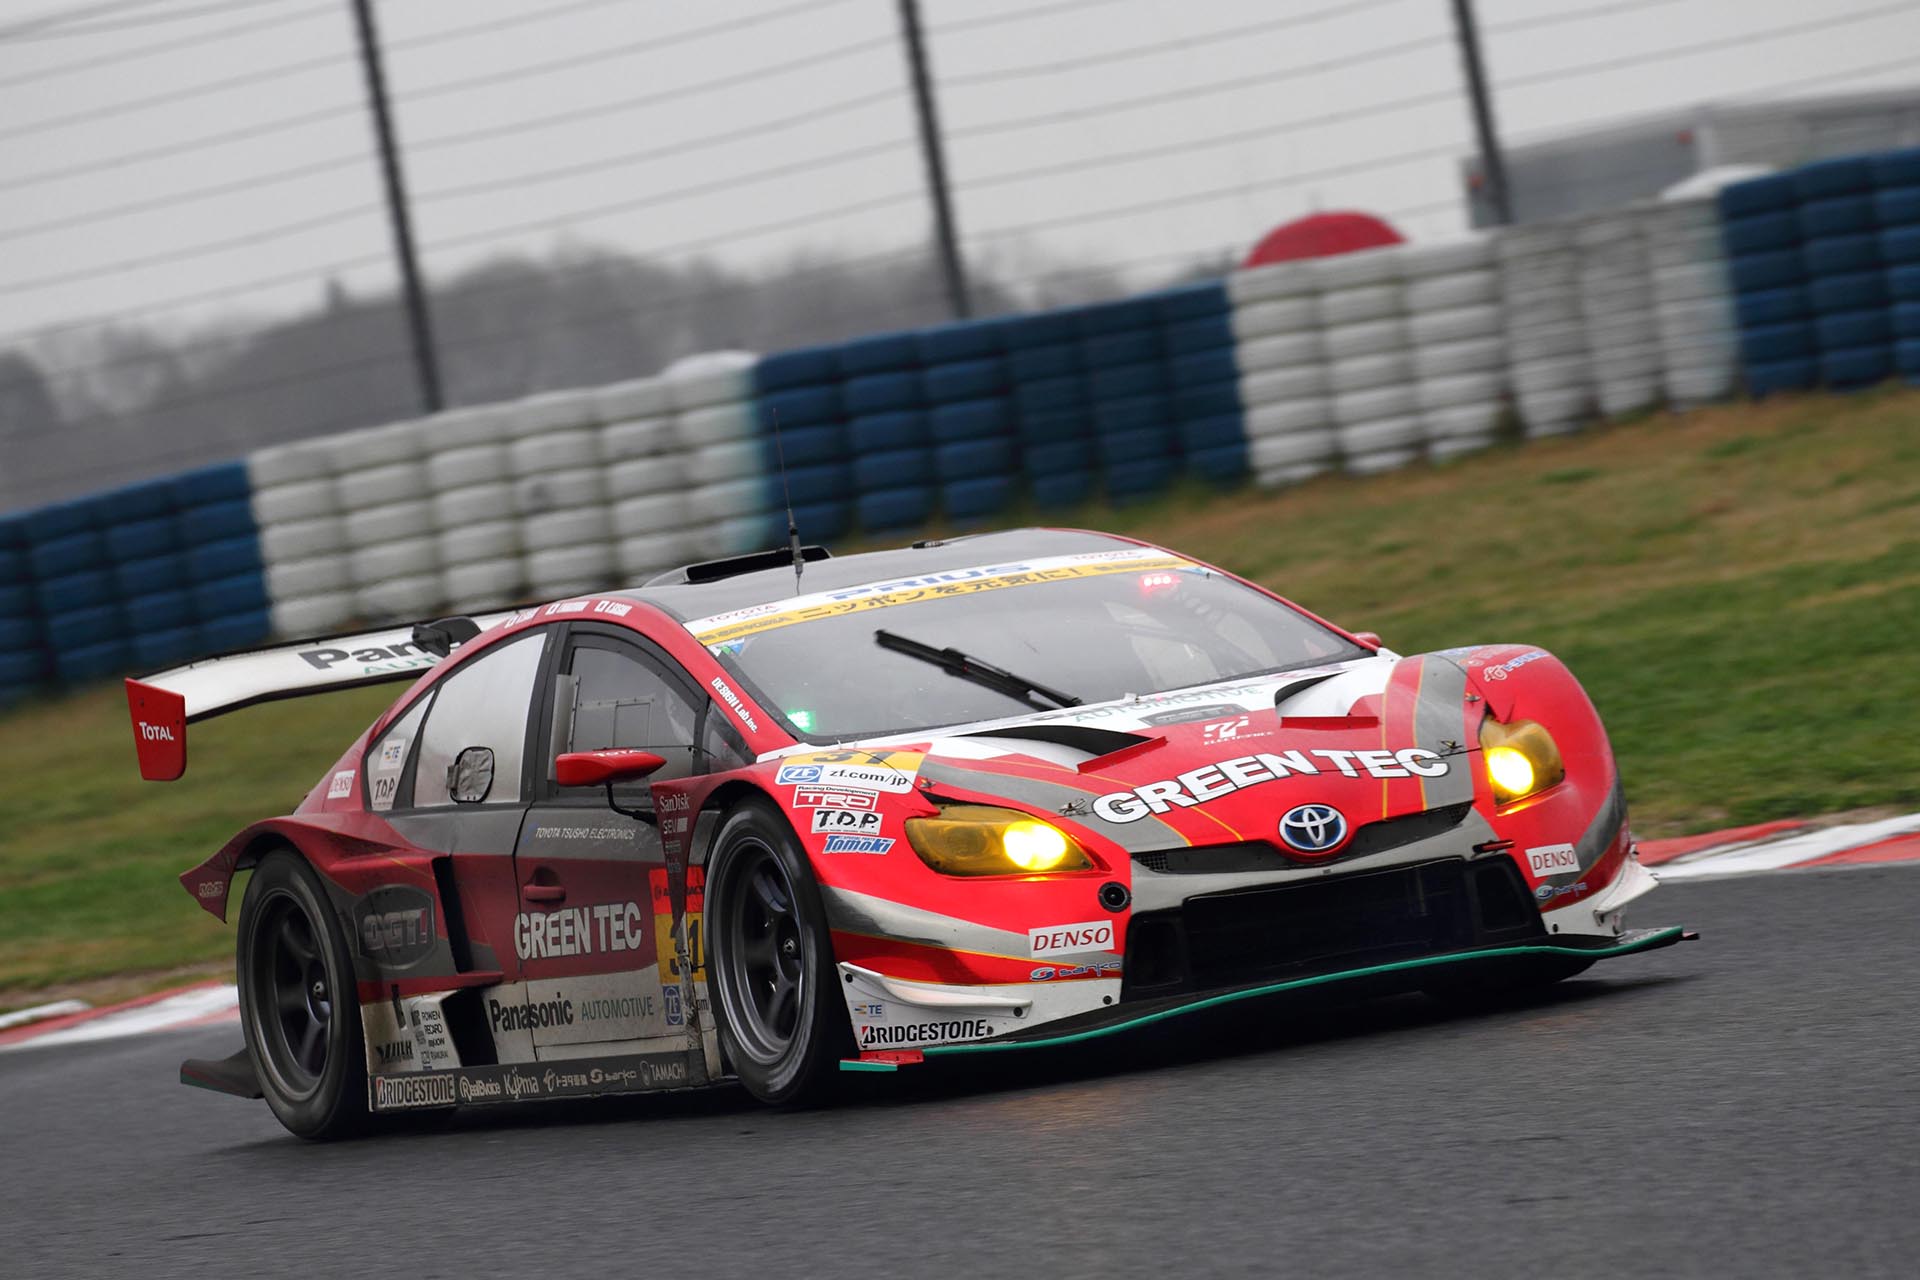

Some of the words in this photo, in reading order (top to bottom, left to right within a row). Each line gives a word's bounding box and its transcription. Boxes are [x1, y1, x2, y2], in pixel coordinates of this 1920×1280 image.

[825, 564, 1031, 601] PRIUS
[707, 604, 777, 624] TOYOTA
[711, 677, 739, 713] DESIGN
[138, 721, 175, 741] TOTAL
[813, 750, 896, 765] 31
[786, 767, 814, 779] ZF
[829, 768, 908, 786] zf.com/jp
[1093, 749, 1320, 824] GREEN
[1310, 748, 1451, 778] TEC
[659, 792, 690, 812] SanDisk
[799, 792, 871, 809] TRD
[535, 827, 561, 839] TOYOTA
[589, 827, 636, 840] ELECTRONICS
[1532, 850, 1575, 871] DENSO
[514, 907, 592, 960] GREEN
[594, 902, 642, 952] TEC
[1033, 927, 1110, 951] DENSO
[489, 992, 574, 1033] Panasonic
[581, 996, 655, 1021] AUTOMOTIVE
[861, 1019, 987, 1044] BRIDGESTONE
[375, 1074, 455, 1106] BRIDGESTONE
